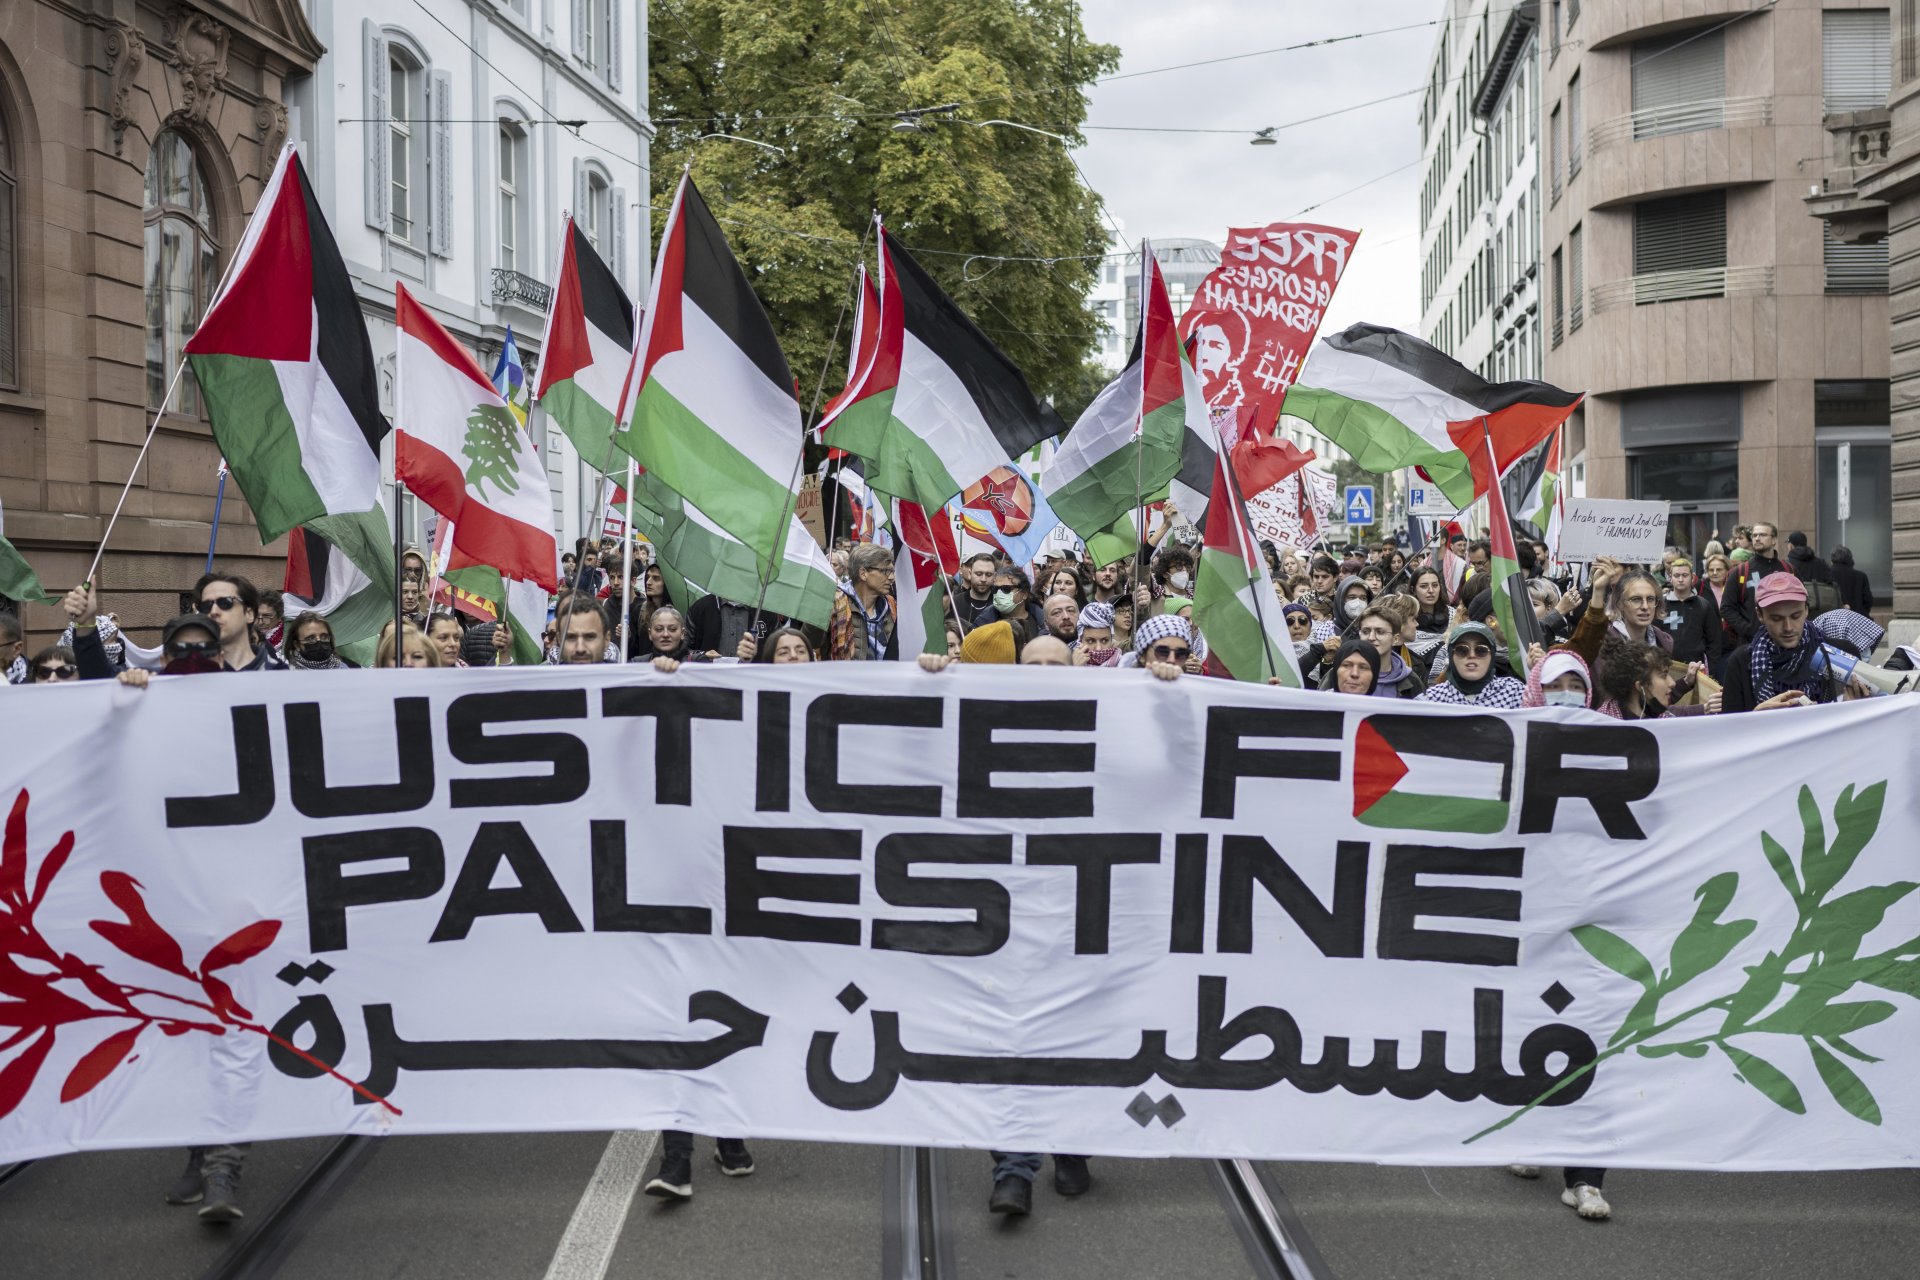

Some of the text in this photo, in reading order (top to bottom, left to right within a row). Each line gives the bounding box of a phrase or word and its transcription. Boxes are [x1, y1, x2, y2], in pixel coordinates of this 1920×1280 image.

[1275, 506, 1297, 520] THE
[1570, 508, 1596, 523] Arabs
[1600, 517, 1615, 525] are
[1619, 514, 1635, 525] not
[1635, 513, 1651, 526] 2nd
[1258, 522, 1290, 541] FOR
[1604, 526, 1642, 539] HUMANS
[165, 685, 1097, 828] JUSTICE
[302, 818, 1525, 966] PALESTINE
[267, 959, 1598, 1128] فلسطين حرة
